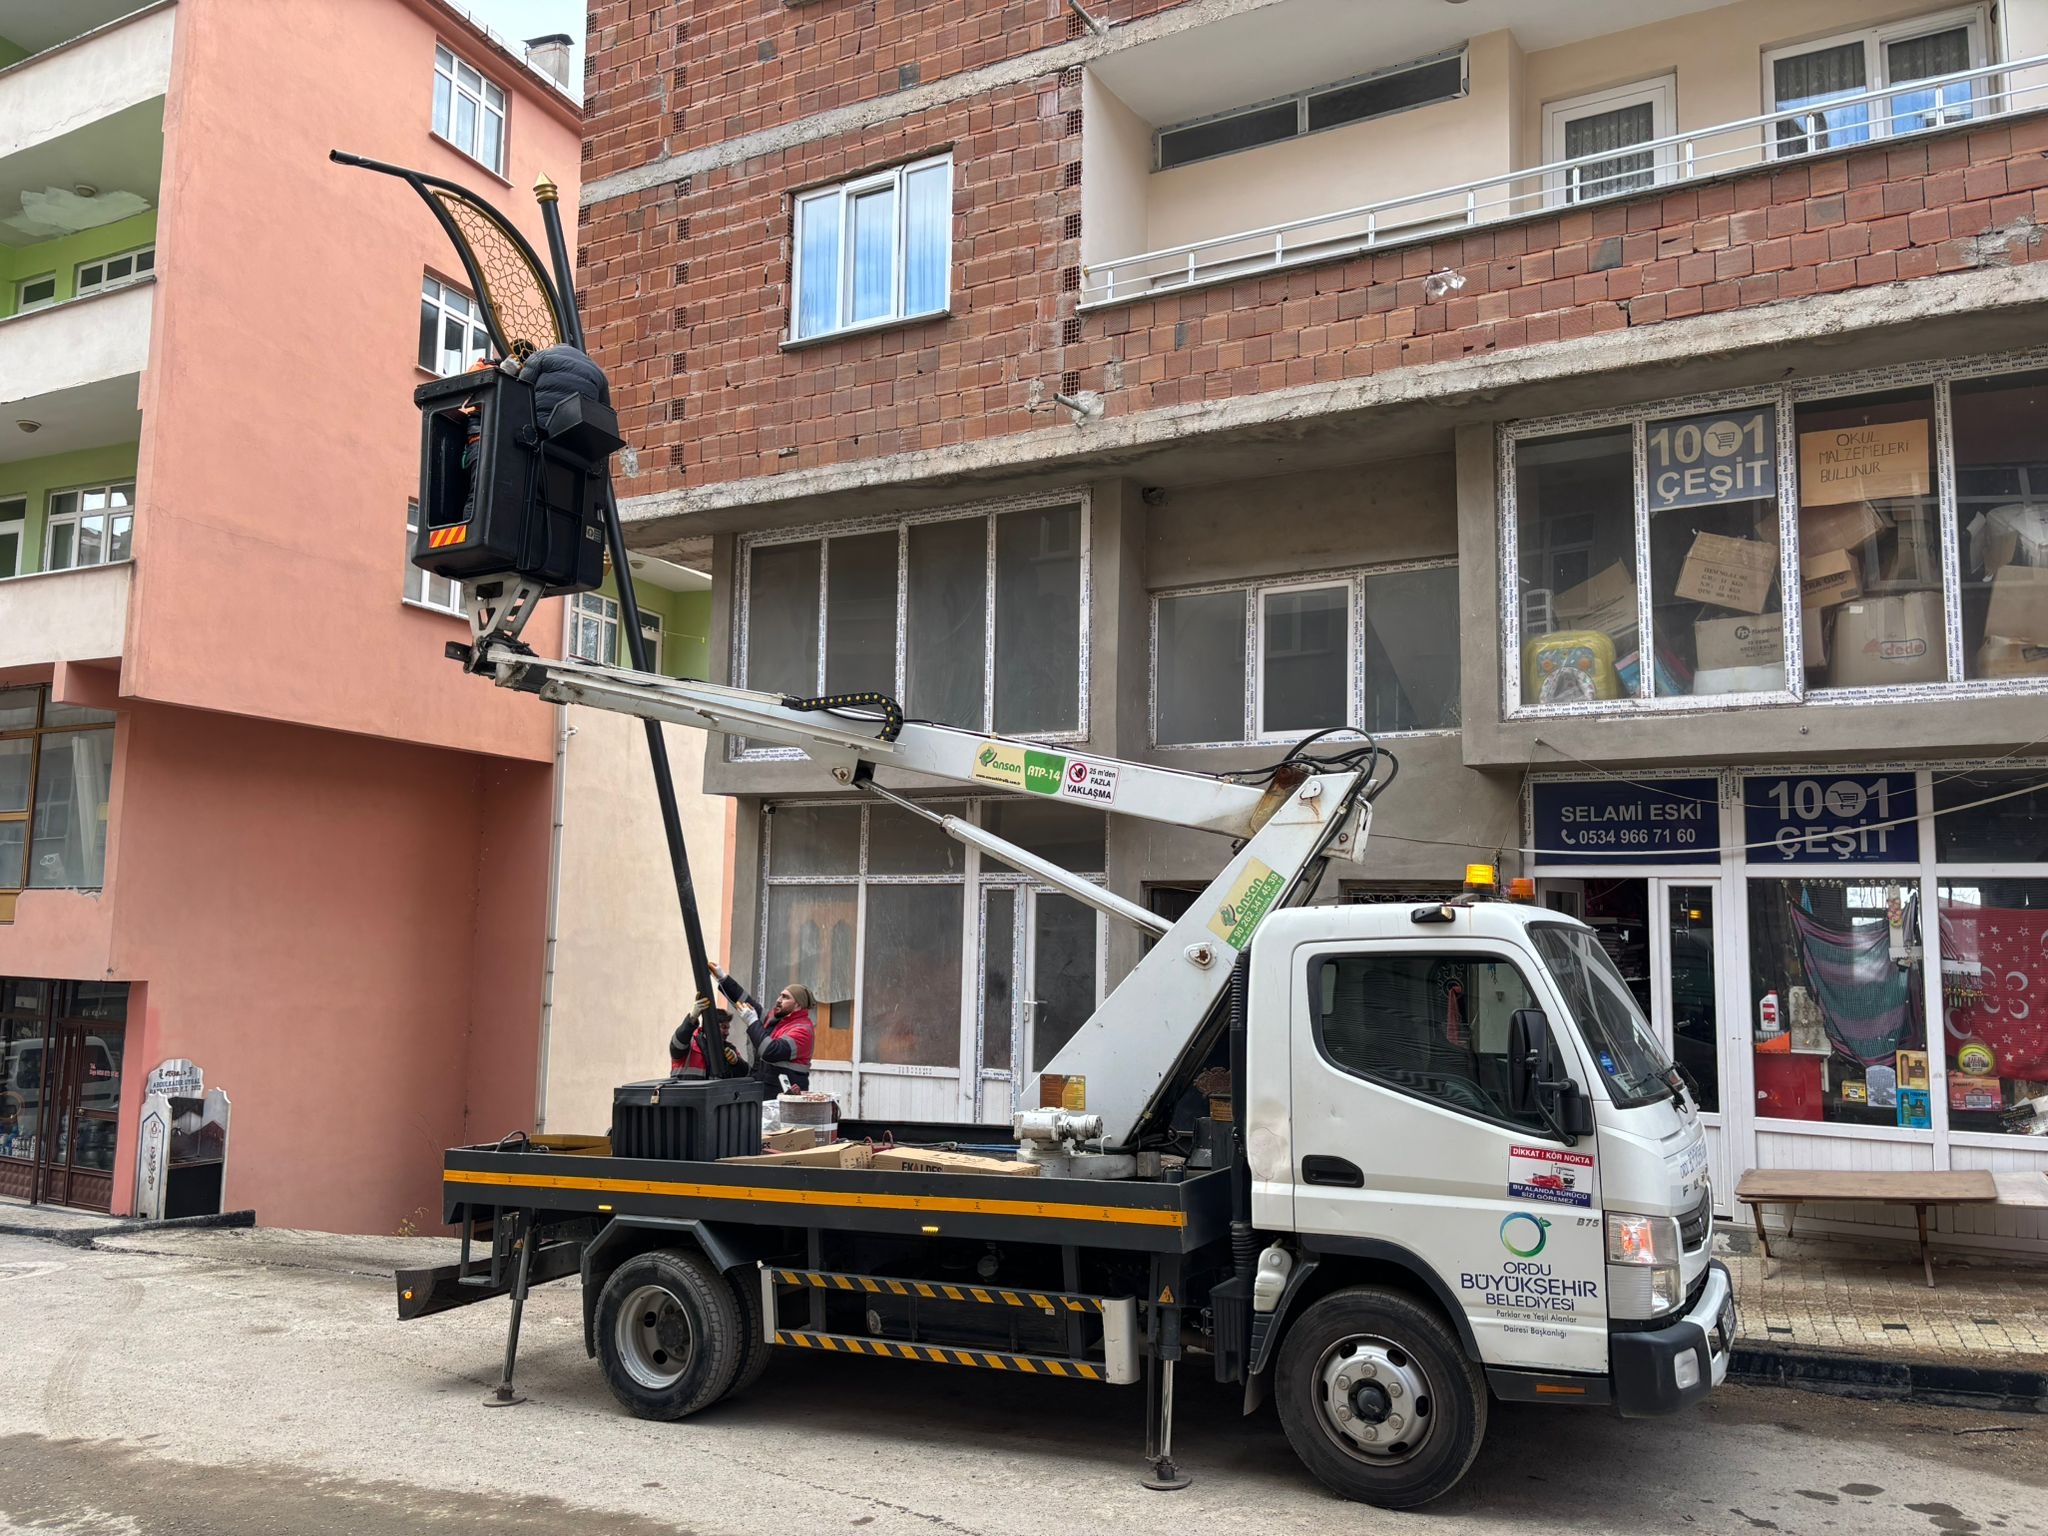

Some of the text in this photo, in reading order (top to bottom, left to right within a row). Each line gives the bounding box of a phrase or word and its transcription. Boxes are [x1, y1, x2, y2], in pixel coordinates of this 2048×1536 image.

[1836, 431, 1879, 447] OKUL
[1820, 461, 1881, 483] BULUNUR
[1656, 456, 1769, 505] ÇEŞİT
[992, 760, 1021, 773] ansan
[1027, 765, 1061, 781] ATP-14
[1089, 767, 1116, 778] 25 m'den
[1090, 777, 1111, 787] FAZLA
[1067, 784, 1112, 800] YAKLAŞMA
[1561, 799, 1702, 822] SELAMİ ESKİ
[1579, 828, 1696, 845] 0534 966 71 60
[1775, 819, 1895, 860] ÇEŞİT
[1235, 878, 1264, 915] ansan
[1241, 911, 1255, 927] 262
[1250, 896, 1264, 912] 341
[1261, 884, 1272, 896] 45
[1267, 873, 1279, 885] 39
[1512, 1147, 1540, 1158] DİKKAT
[1545, 1151, 1563, 1161] KÖR
[1564, 1154, 1590, 1164] NOKTA
[1524, 1185, 1554, 1196] ALANDA
[1536, 1193, 1573, 1205] GÖREMEZ
[1576, 1217, 1600, 1228] B75
[1503, 1261, 1552, 1276] ORDU
[1460, 1272, 1598, 1298] BÜYÜKŞEHİR
[1485, 1292, 1575, 1312] BELEDİYESİ
[1496, 1309, 1521, 1319] Parklar
[1533, 1312, 1549, 1323] Yeşil
[1550, 1314, 1578, 1324] Alanlar
[1503, 1324, 1567, 1340] Dairesi Başkanlığı
